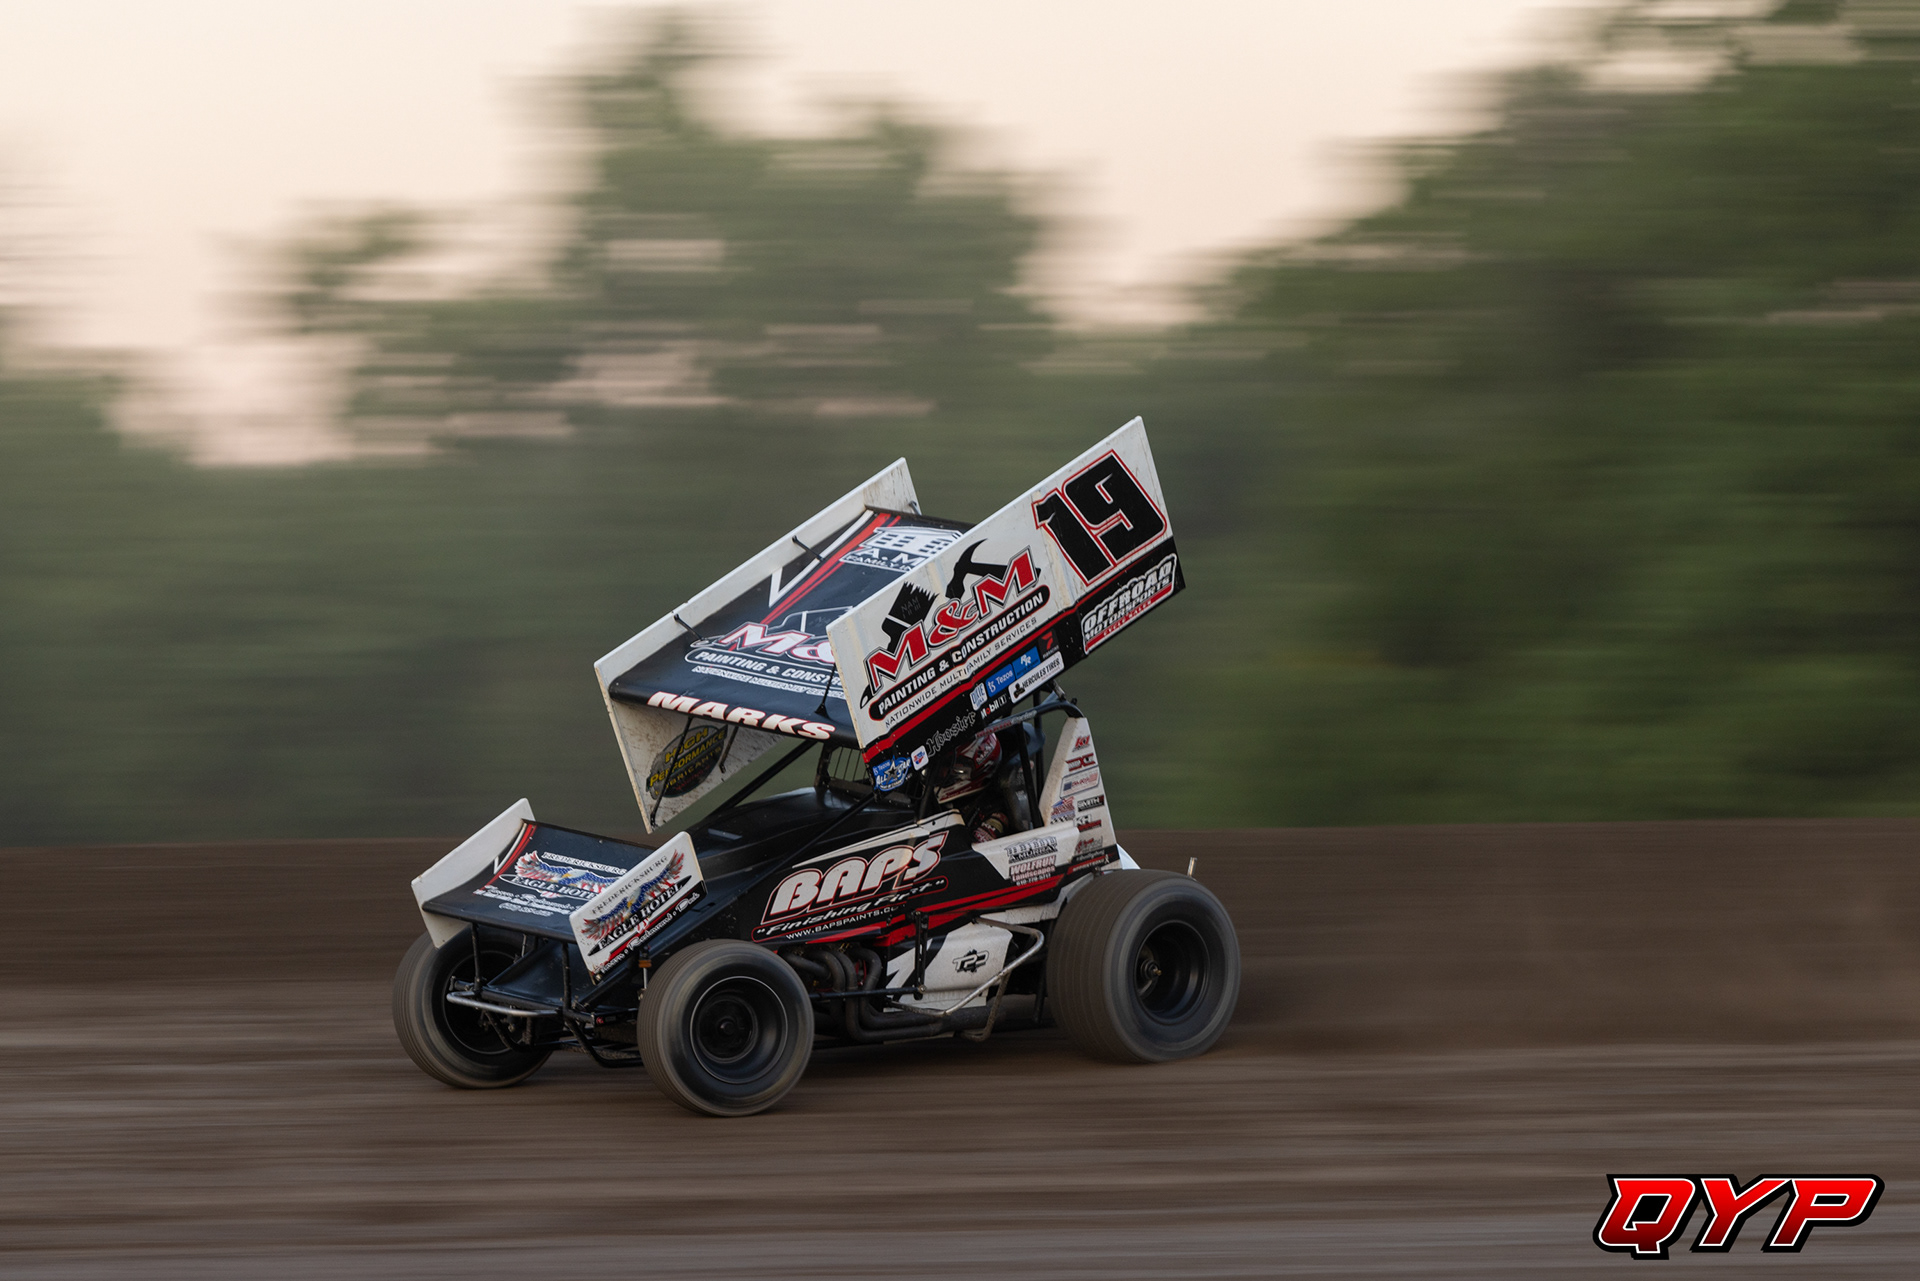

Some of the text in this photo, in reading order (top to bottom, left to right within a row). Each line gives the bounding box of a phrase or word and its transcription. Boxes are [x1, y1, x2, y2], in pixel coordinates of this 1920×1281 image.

[1033, 451, 1166, 584] 19
[864, 547, 1037, 694] M&M
[1084, 561, 1172, 632] OFFROAD
[1085, 577, 1170, 640] MOTORSPORTS
[695, 651, 767, 671] PAINTING
[766, 665, 780, 675] &
[878, 592, 1044, 715] PAINTING & CONSTRUCTION
[885, 618, 1038, 729] NATIONWIDE MULTIFAMILY SERVICES
[996, 669, 1014, 685] Tezos
[1022, 668, 1045, 688] HERCULES
[1045, 658, 1060, 676] TIRES
[648, 691, 836, 740] MARKS
[925, 711, 976, 757] Hoosier
[980, 700, 999, 720] Mobil
[511, 877, 559, 893] EAGLE
[541, 852, 628, 875] FREDERICKSBURG
[592, 855, 668, 915] FREDERICKSBURG
[764, 831, 948, 921] BAPS
[1010, 856, 1056, 875] WOLFRUN
[599, 884, 683, 950] EAGLE HOTEL
